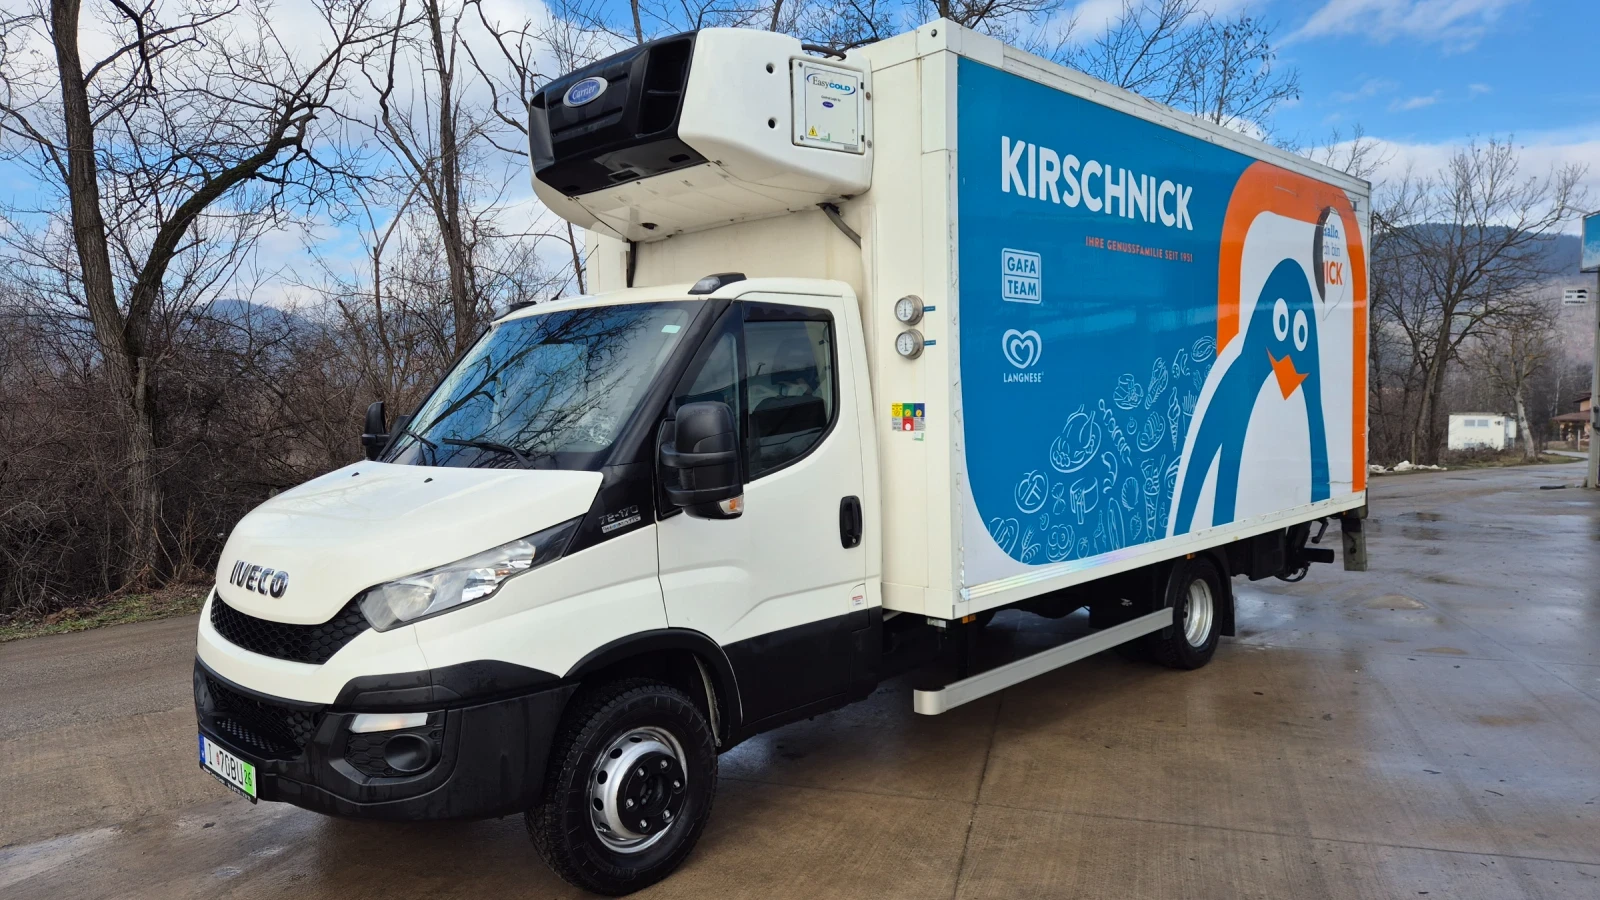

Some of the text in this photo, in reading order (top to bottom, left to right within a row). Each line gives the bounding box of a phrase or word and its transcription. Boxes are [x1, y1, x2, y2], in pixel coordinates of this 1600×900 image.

[572, 84, 597, 101] Carrier
[812, 76, 851, 92] EasyCOLD
[1002, 135, 1194, 231] KIRSCHNICK
[1085, 236, 1193, 263] IHRE GENUSSFAMILIE SEIT 1951
[1007, 256, 1037, 275] GAFA
[1007, 279, 1037, 297] TEAM
[1003, 372, 1042, 383] LANGNESE
[229, 559, 289, 599] IVECO
